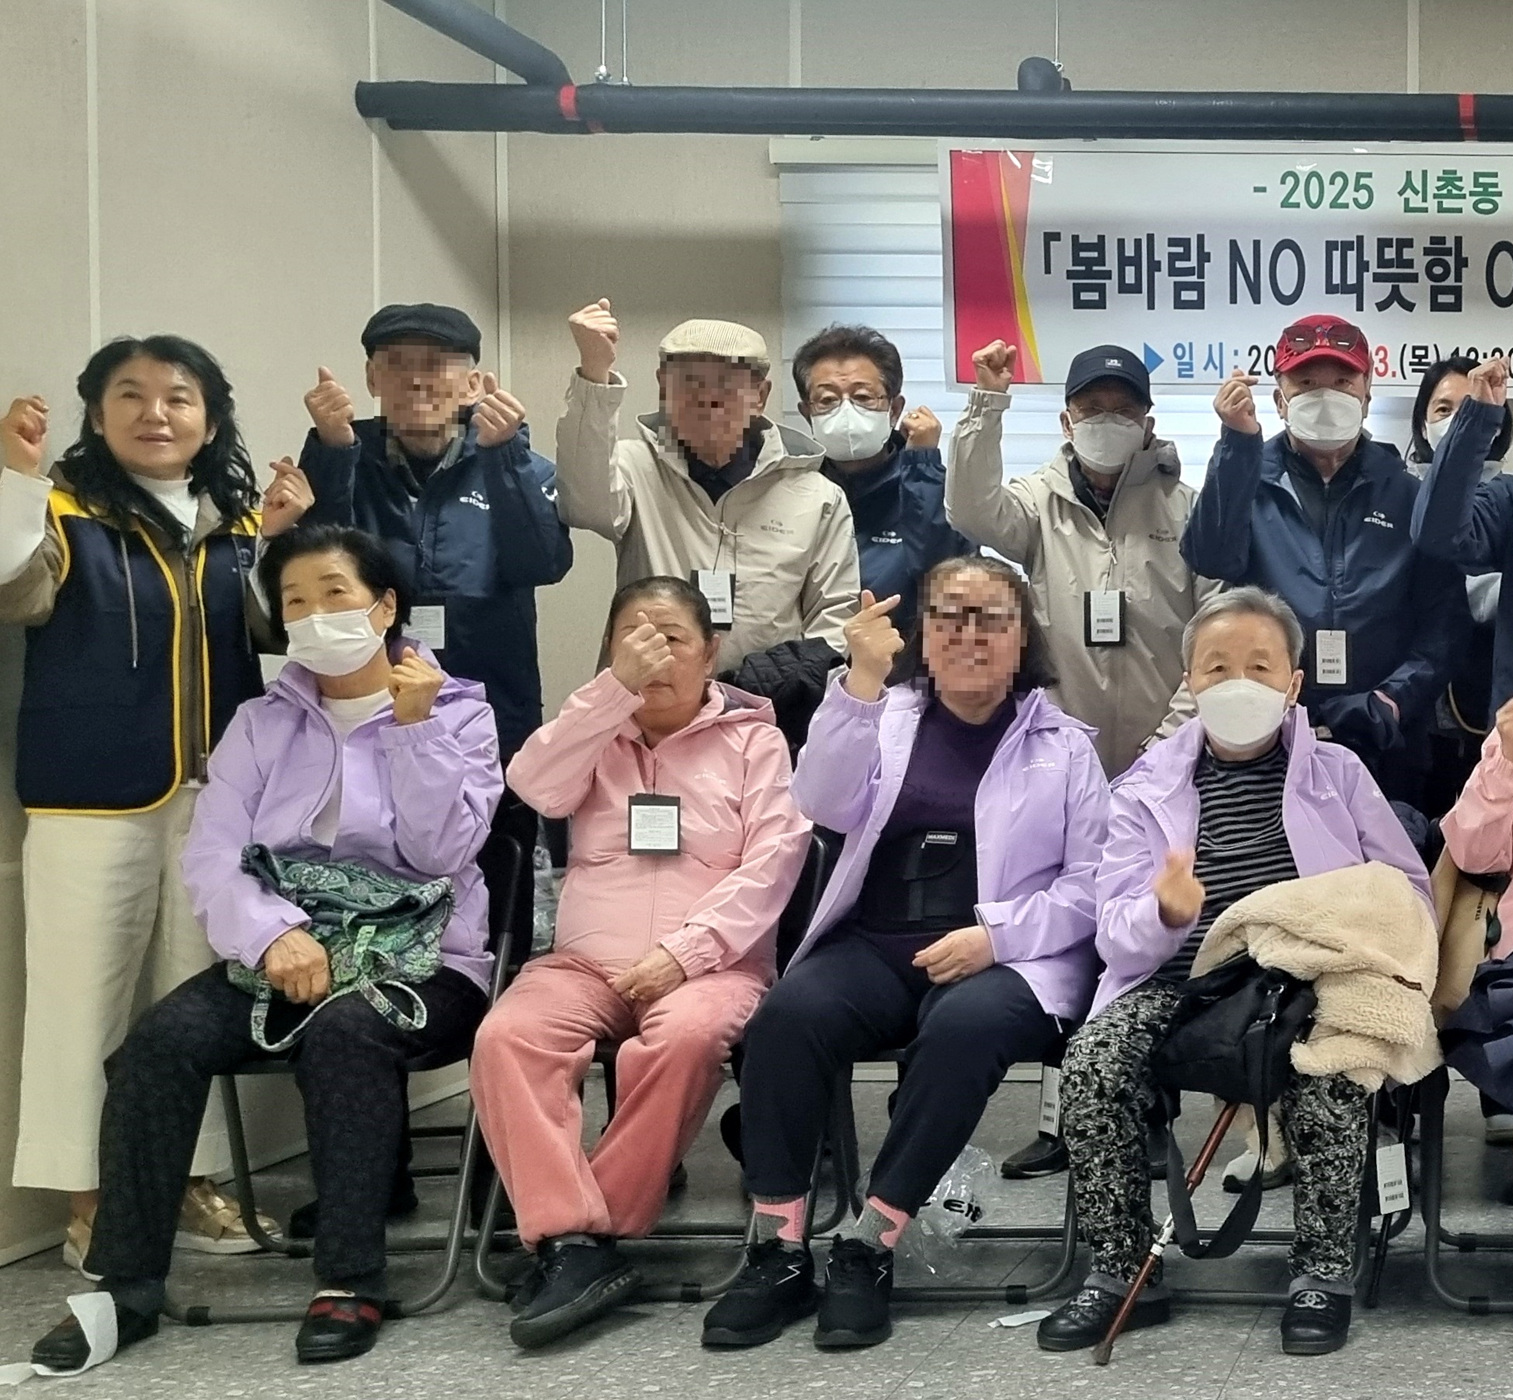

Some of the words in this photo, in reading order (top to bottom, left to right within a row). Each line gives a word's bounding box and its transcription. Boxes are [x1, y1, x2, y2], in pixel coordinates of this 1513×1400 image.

[1279, 170, 1375, 210] 2025
[1397, 169, 1503, 216] 신촌동
[1228, 238, 1306, 307] NO
[1324, 234, 1470, 313] 따뜻함
